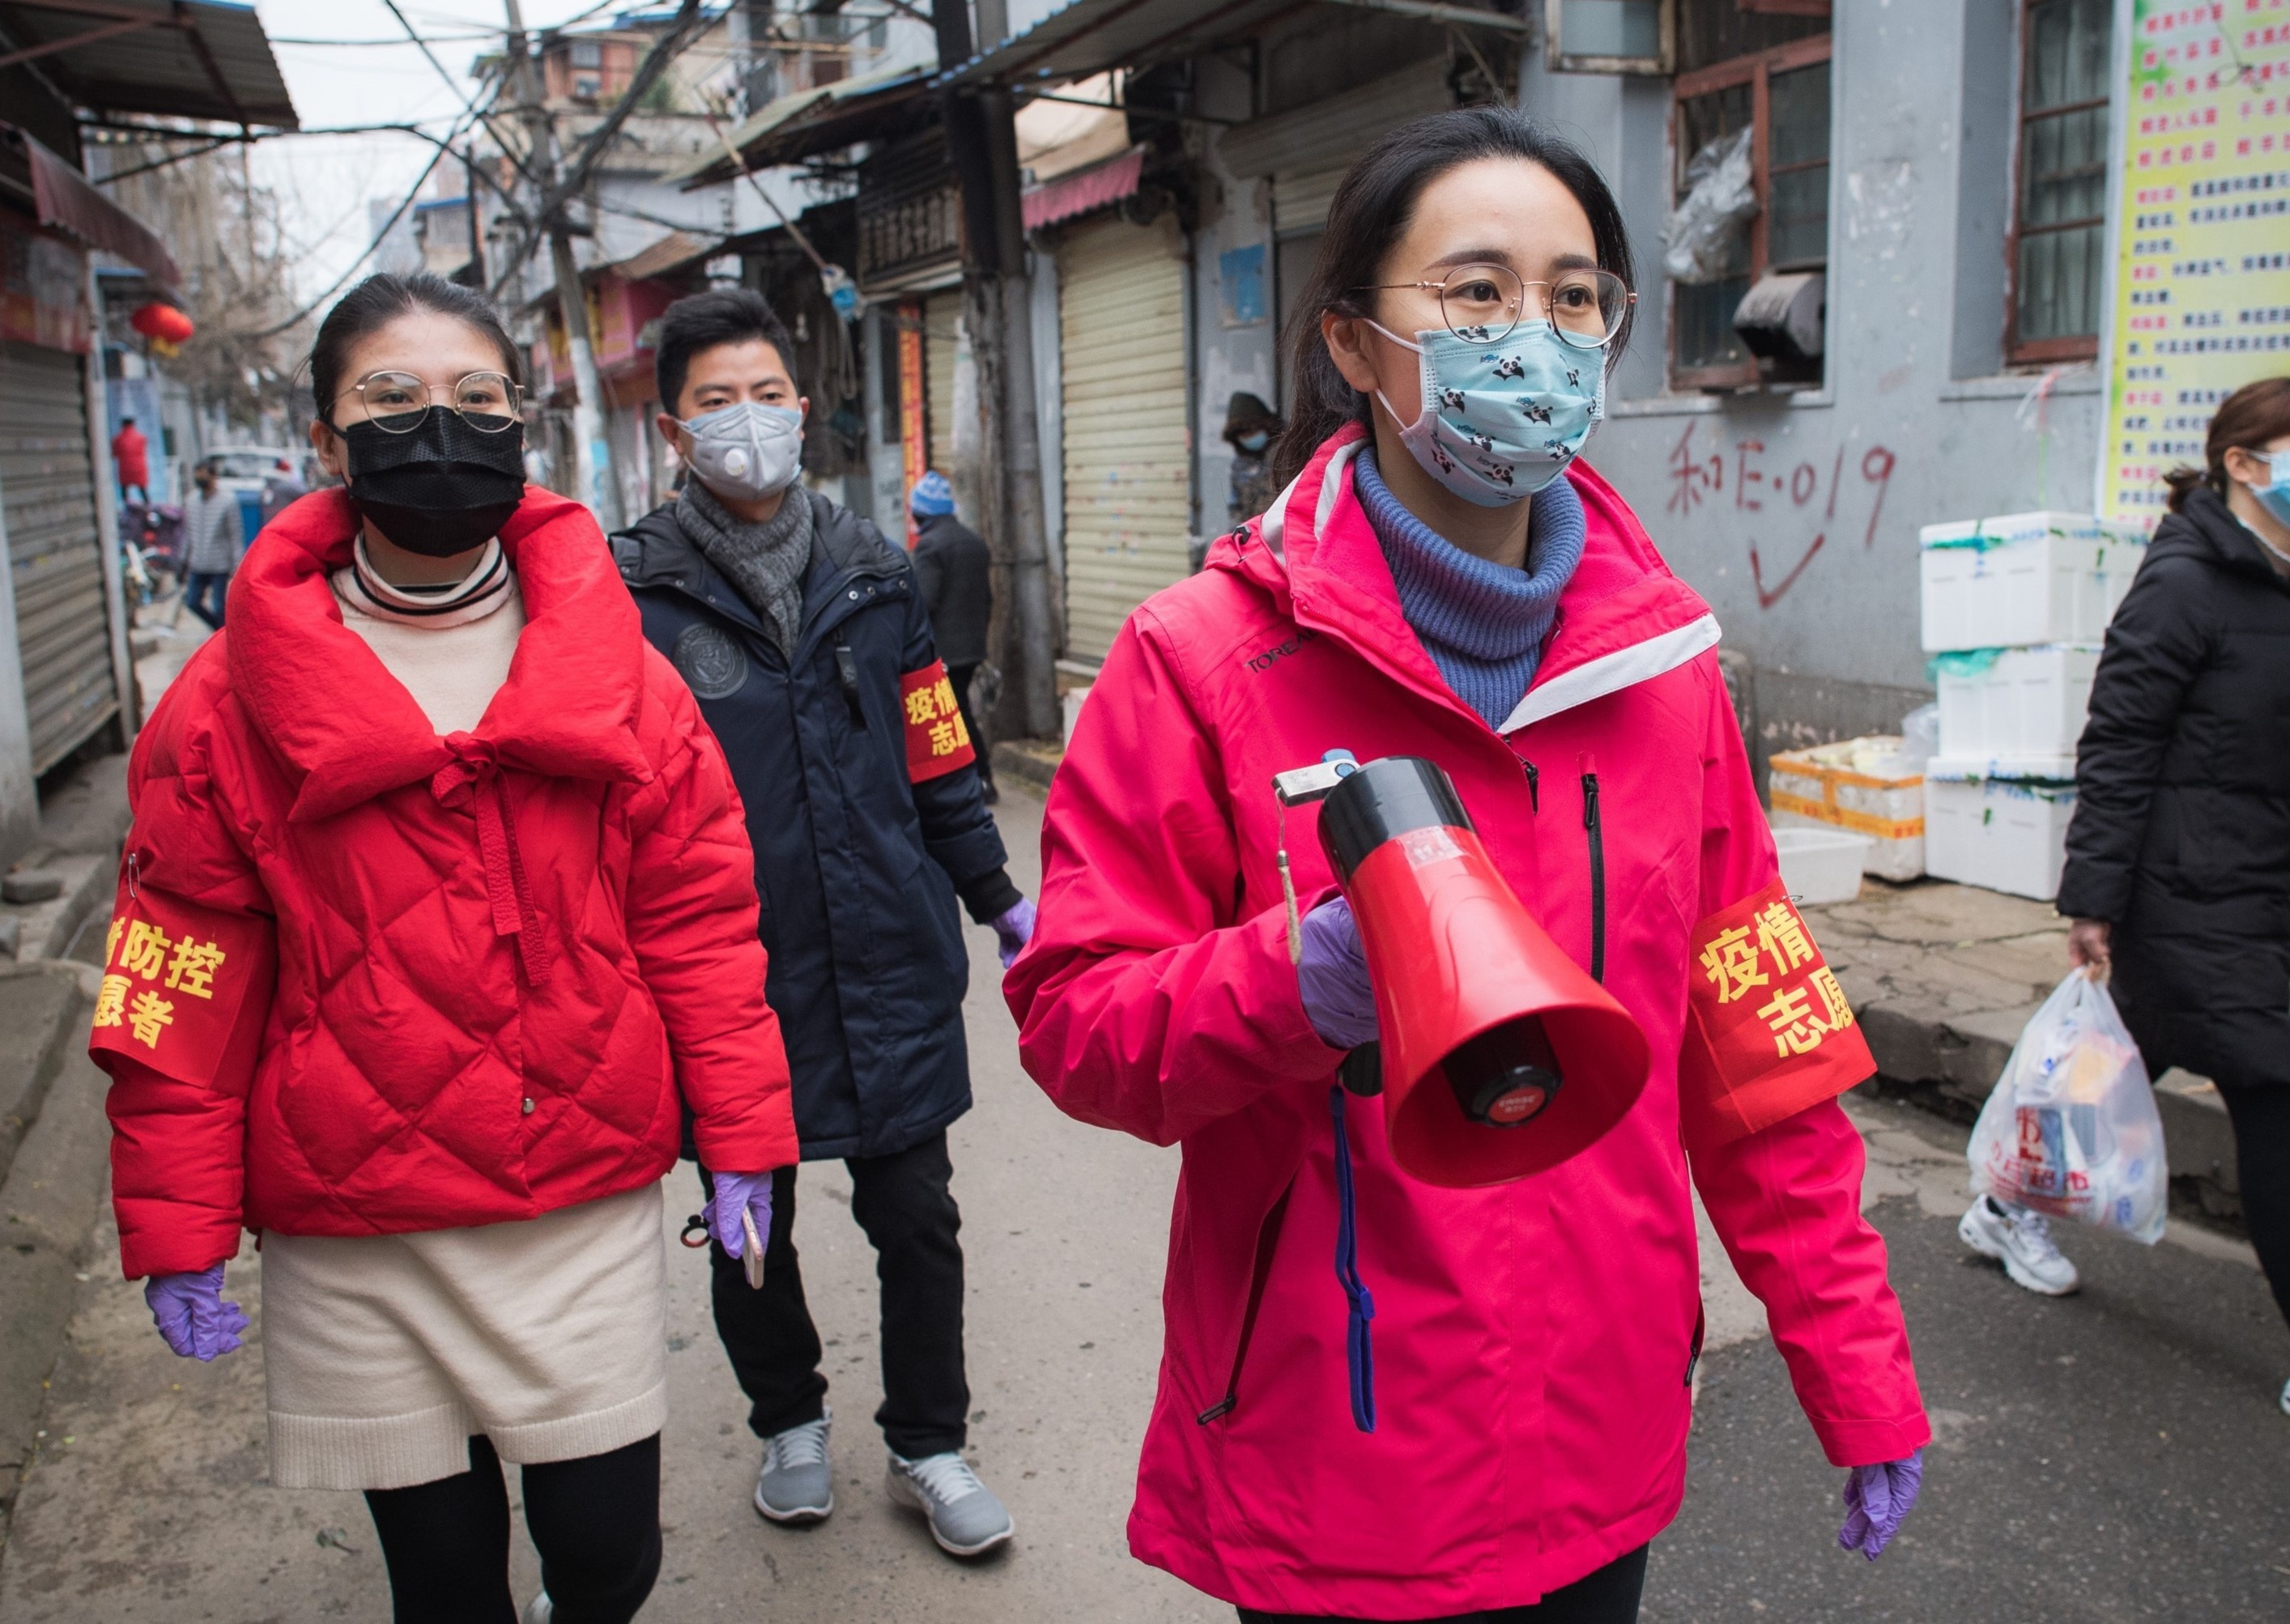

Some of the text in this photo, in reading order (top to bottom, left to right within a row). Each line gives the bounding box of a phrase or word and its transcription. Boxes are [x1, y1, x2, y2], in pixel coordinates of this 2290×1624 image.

[905, 678, 959, 725] 疫情
[1699, 902, 1815, 1004] 疫情
[93, 974, 175, 1050] 愿者
[1756, 965, 1854, 1058] 志愿
